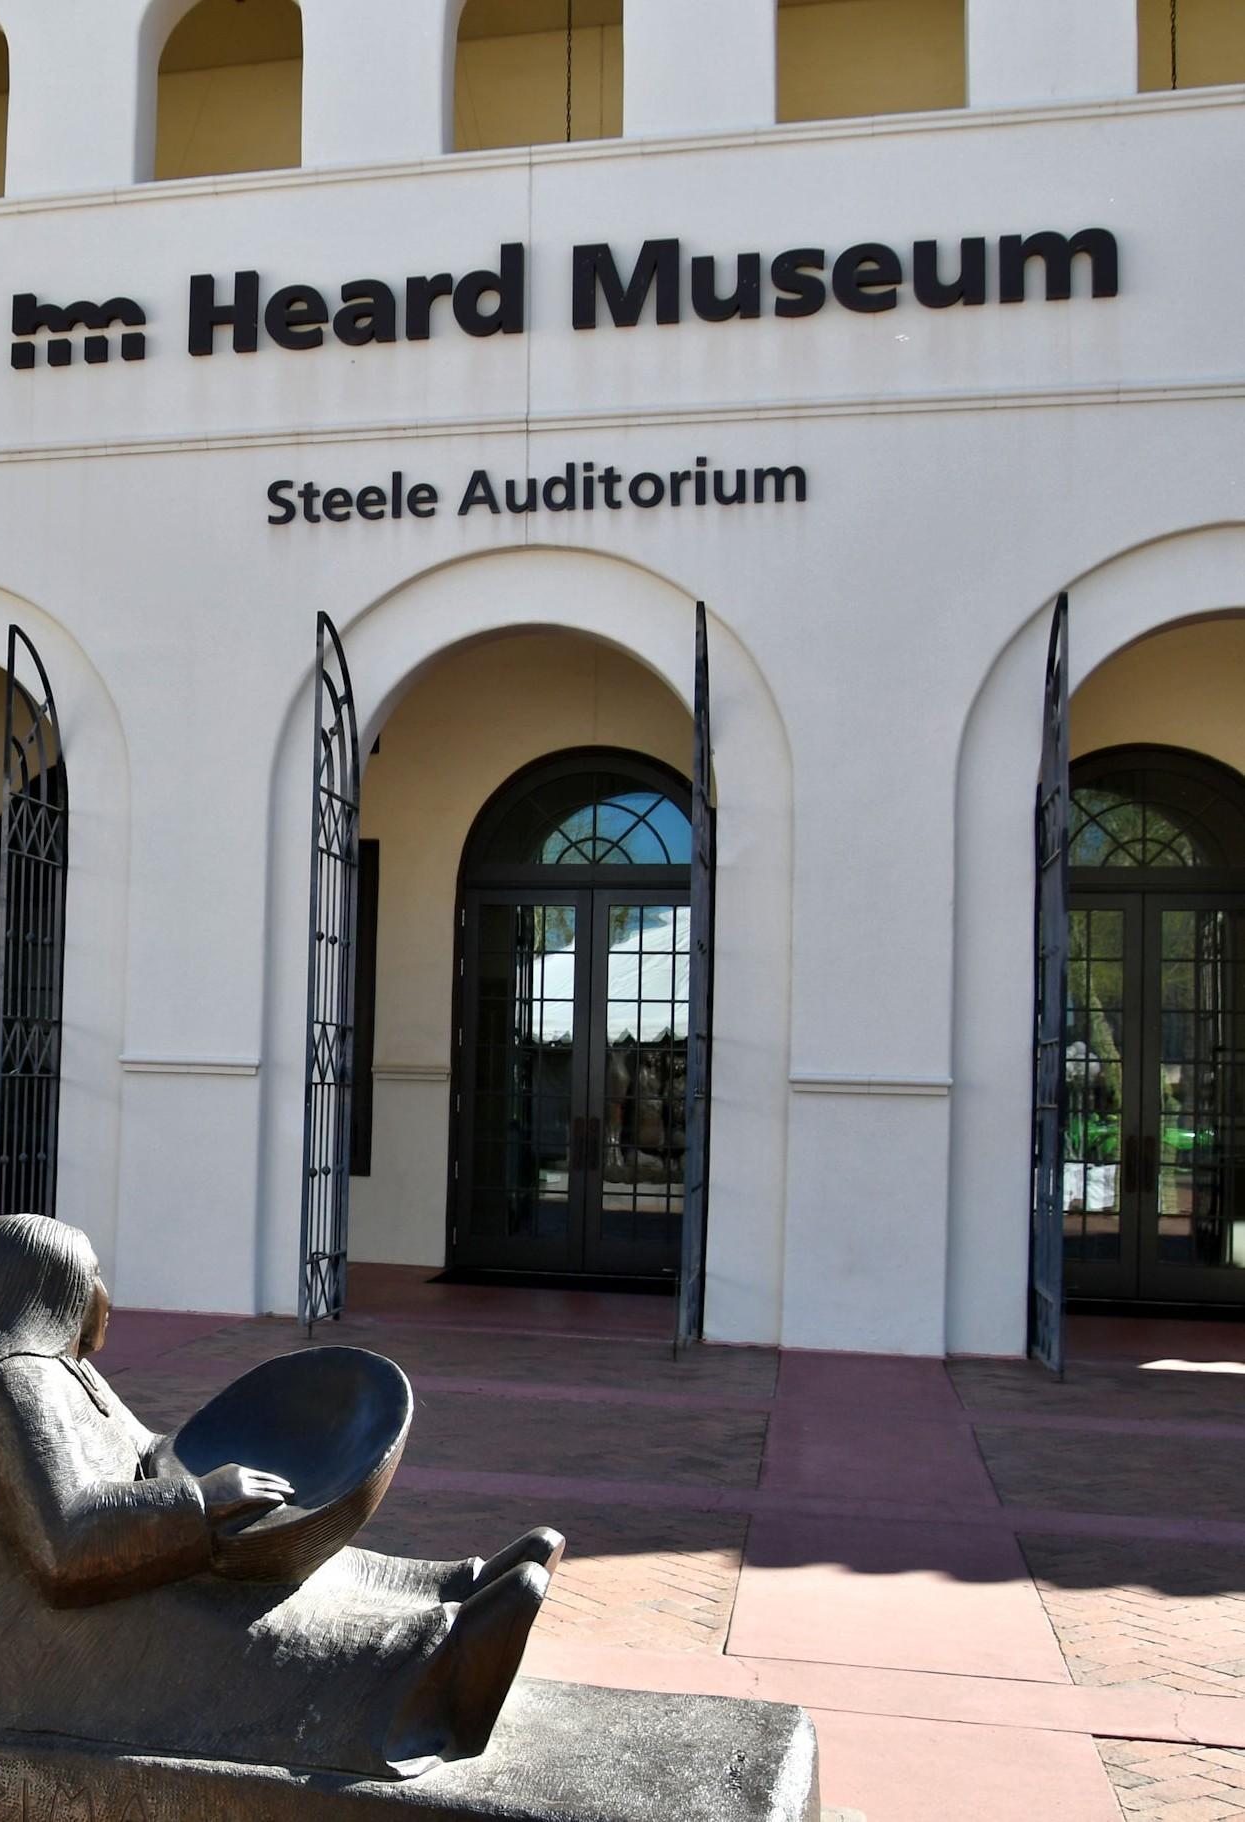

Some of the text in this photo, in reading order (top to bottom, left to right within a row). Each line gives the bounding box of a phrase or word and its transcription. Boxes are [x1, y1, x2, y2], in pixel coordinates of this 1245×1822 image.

[188, 242, 525, 357] Heard
[572, 228, 1119, 331] Museum
[267, 457, 807, 525] Steele Auditorium
